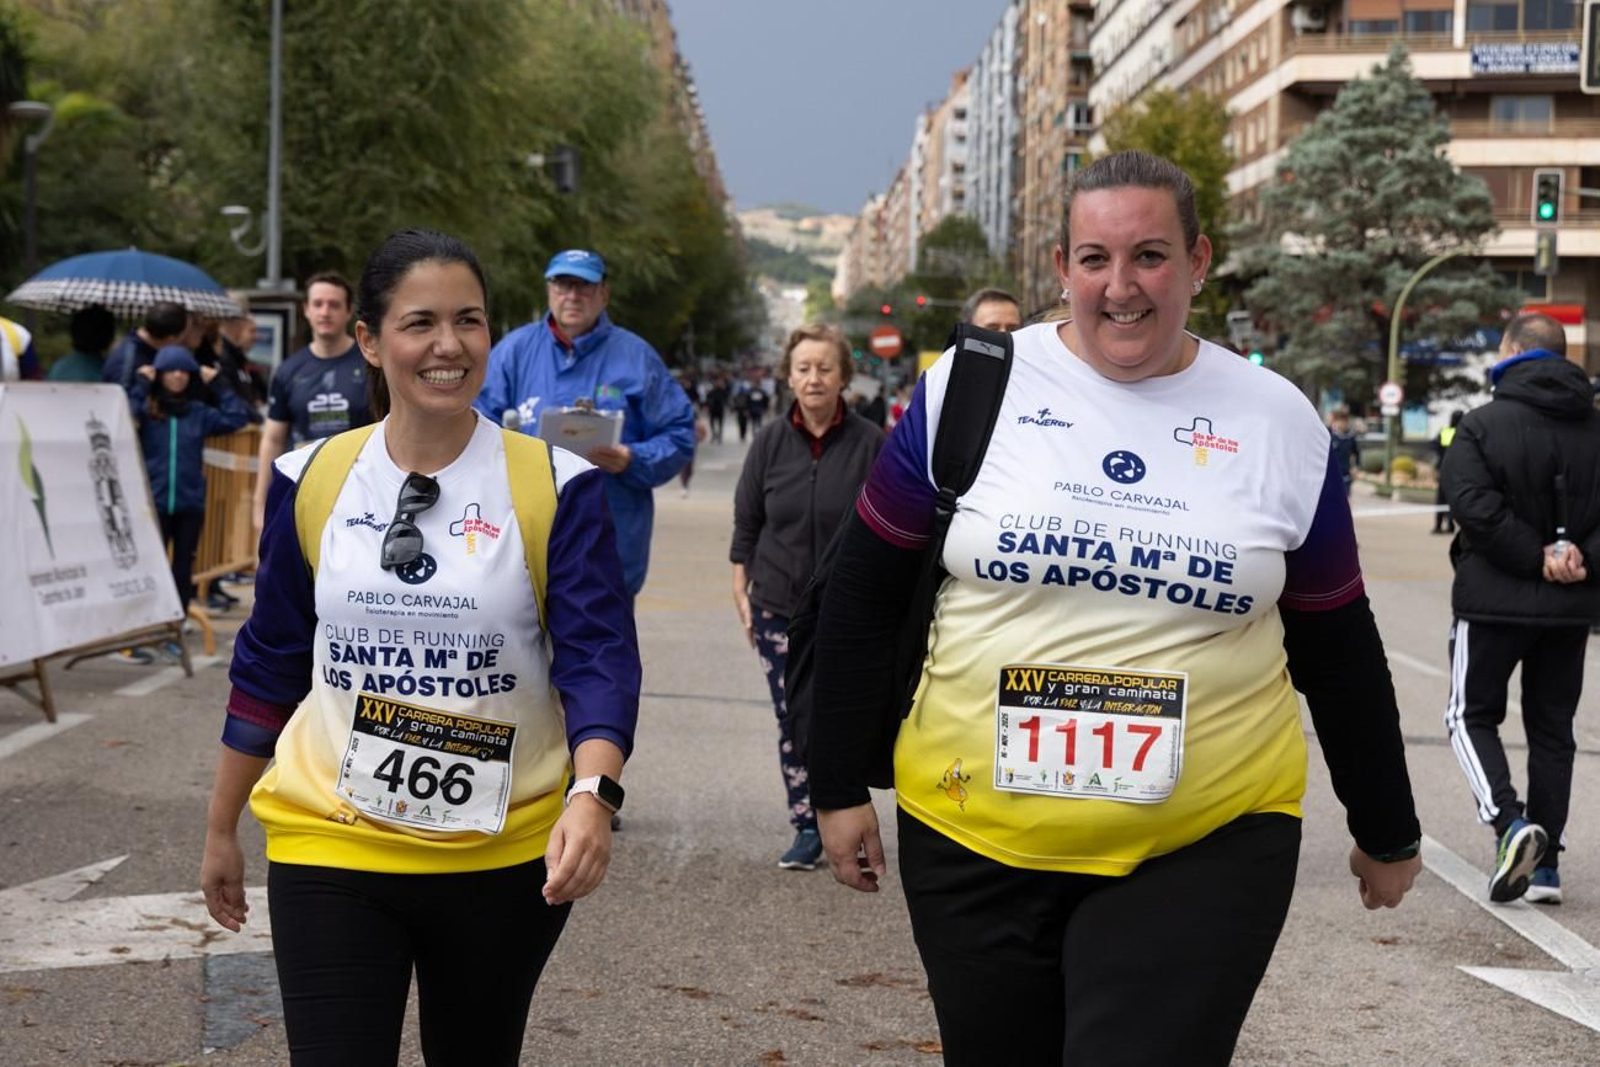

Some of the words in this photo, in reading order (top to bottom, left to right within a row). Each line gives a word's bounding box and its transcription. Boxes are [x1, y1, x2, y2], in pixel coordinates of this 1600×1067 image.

[307, 393, 350, 412] 25
[1054, 482, 1104, 496] PABLO
[1110, 490, 1190, 511] CARVAJAL
[1000, 514, 1062, 531] CLUB
[1074, 520, 1108, 538] DE
[1120, 527, 1237, 560] RUNNING
[997, 532, 1116, 563] SANTA
[1130, 546, 1176, 570] Mª
[1188, 555, 1234, 584] DE
[347, 590, 396, 605] PABLO
[402, 594, 478, 610] CARVAJAL
[975, 558, 1030, 583] LOS
[1042, 564, 1254, 615] APÓSTOLES
[366, 608, 405, 617] fisioterapia
[418, 611, 458, 619] movimiento
[326, 624, 369, 642] CLUB
[379, 629, 404, 644] DE
[414, 631, 504, 648] RUNNING
[330, 642, 414, 668] SANTA
[425, 649, 458, 668] Mª
[467, 650, 499, 670] DE
[324, 665, 352, 690] LOS
[362, 670, 516, 698] APÓSTOLES
[1006, 670, 1044, 692] XXV
[1048, 672, 1113, 685] CARRERA
[1114, 676, 1177, 690] POPULAR
[1048, 682, 1056, 694] y
[1065, 684, 1100, 696] gran
[1109, 687, 1176, 700] caminata
[1023, 695, 1042, 704] POR
[1044, 696, 1058, 706] LA
[1060, 698, 1078, 708] PAZ
[1088, 700, 1102, 710] LA
[360, 698, 396, 724] XXV
[398, 708, 453, 727] CARRERA
[456, 718, 510, 737] POPULAR
[395, 716, 404, 728] y
[410, 720, 443, 734] gran
[451, 728, 508, 746] caminata
[374, 726, 390, 736] POR
[390, 730, 404, 740] LA
[404, 732, 422, 742] PAZ
[429, 739, 443, 748] LA
[1018, 716, 1162, 772] 1117
[372, 749, 476, 806] 466
